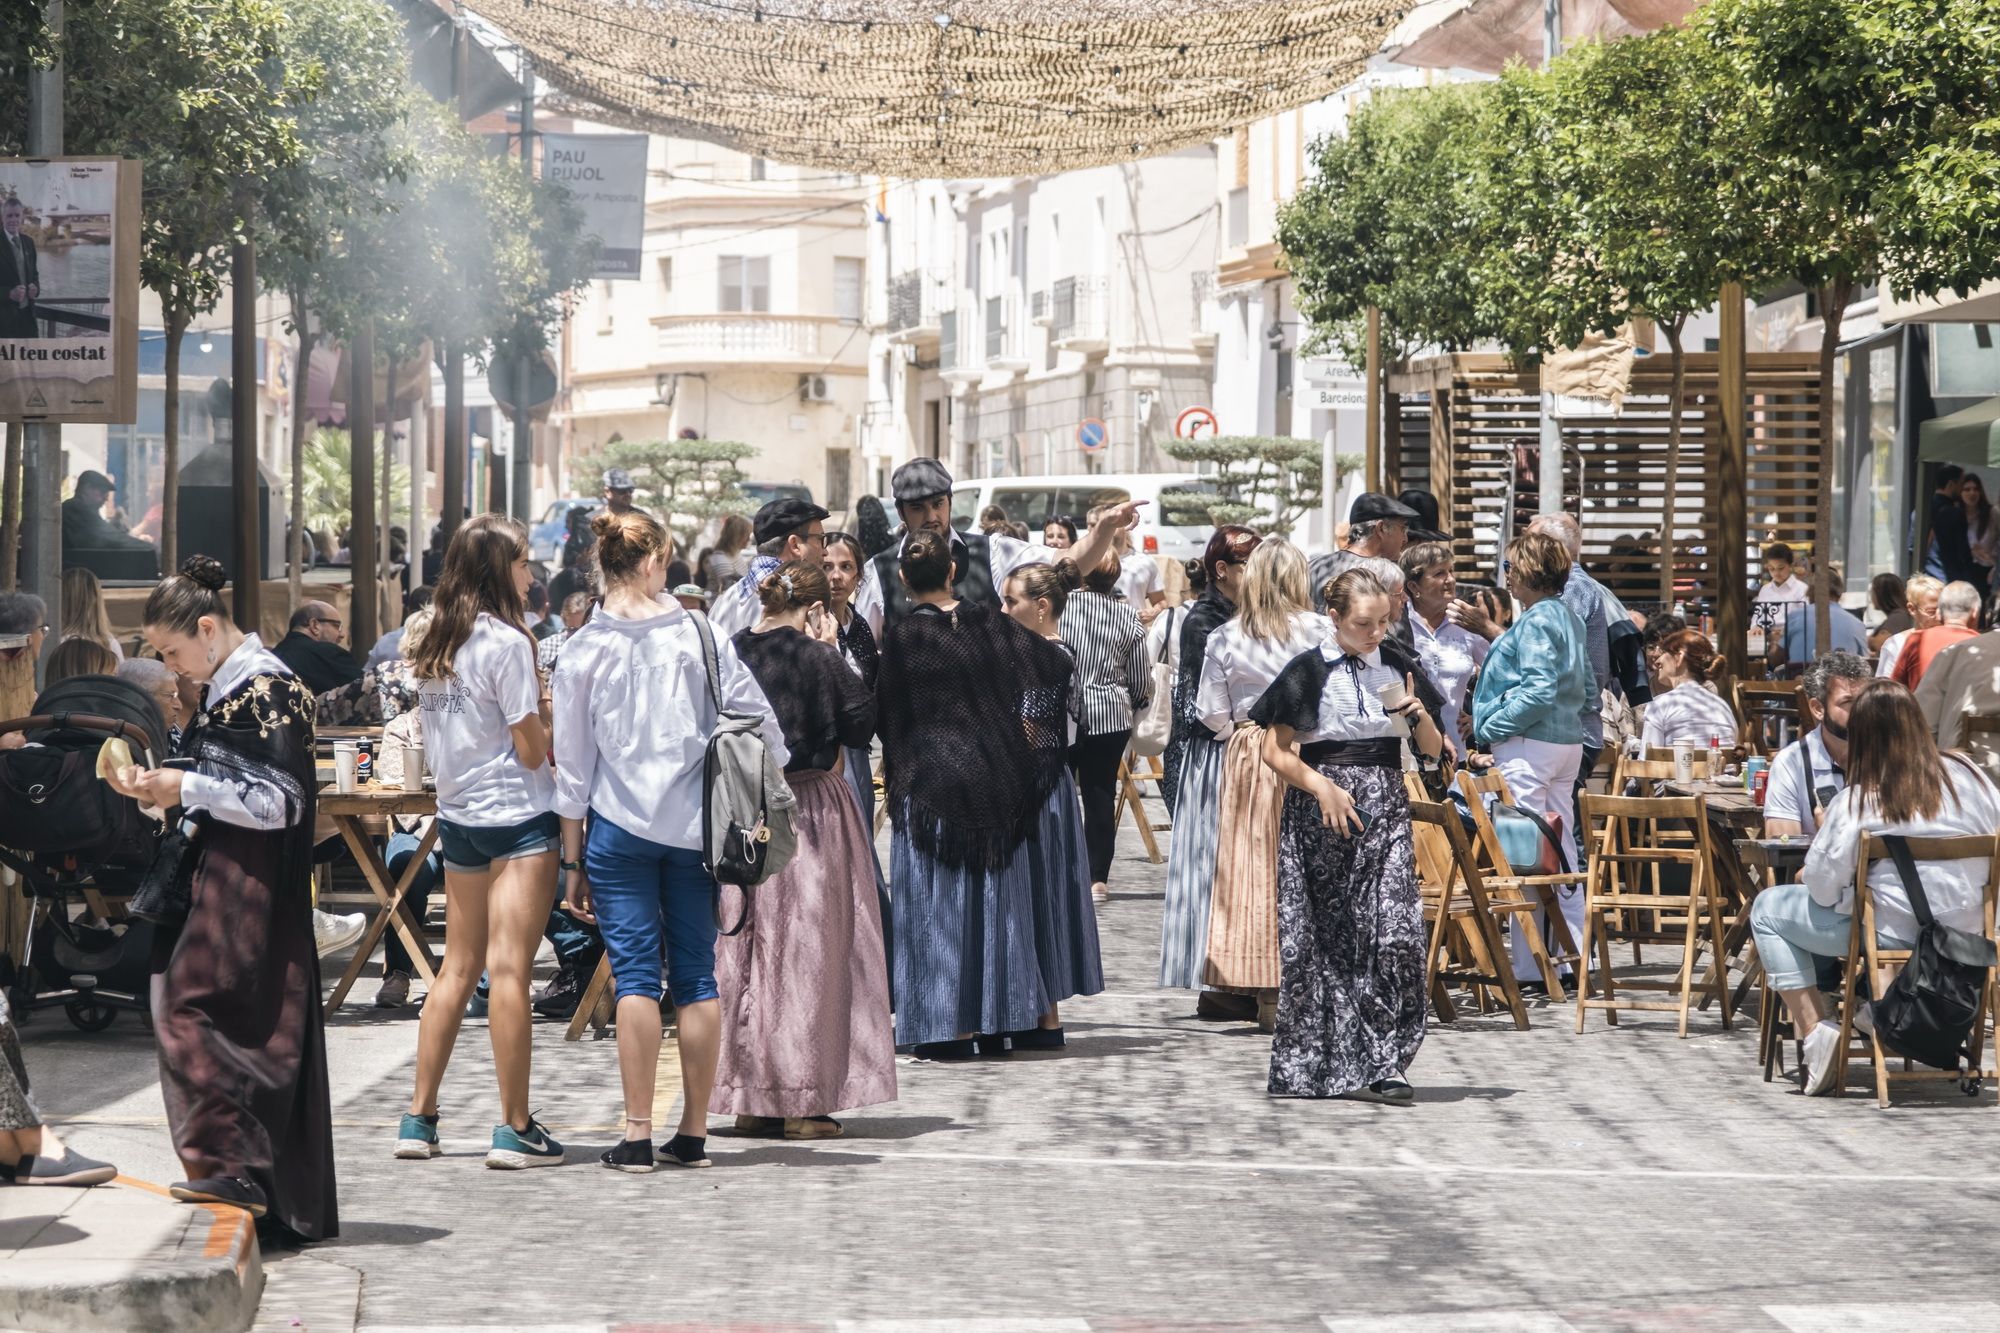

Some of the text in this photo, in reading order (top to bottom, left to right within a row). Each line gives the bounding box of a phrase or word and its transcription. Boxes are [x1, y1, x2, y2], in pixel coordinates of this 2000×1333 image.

[553, 150, 585, 164] PAU
[552, 167, 605, 180] PUJOL
[0, 344, 106, 360] Al teu costat
[1320, 391, 1367, 403] Barcelona
[760, 830, 766, 840] Z
